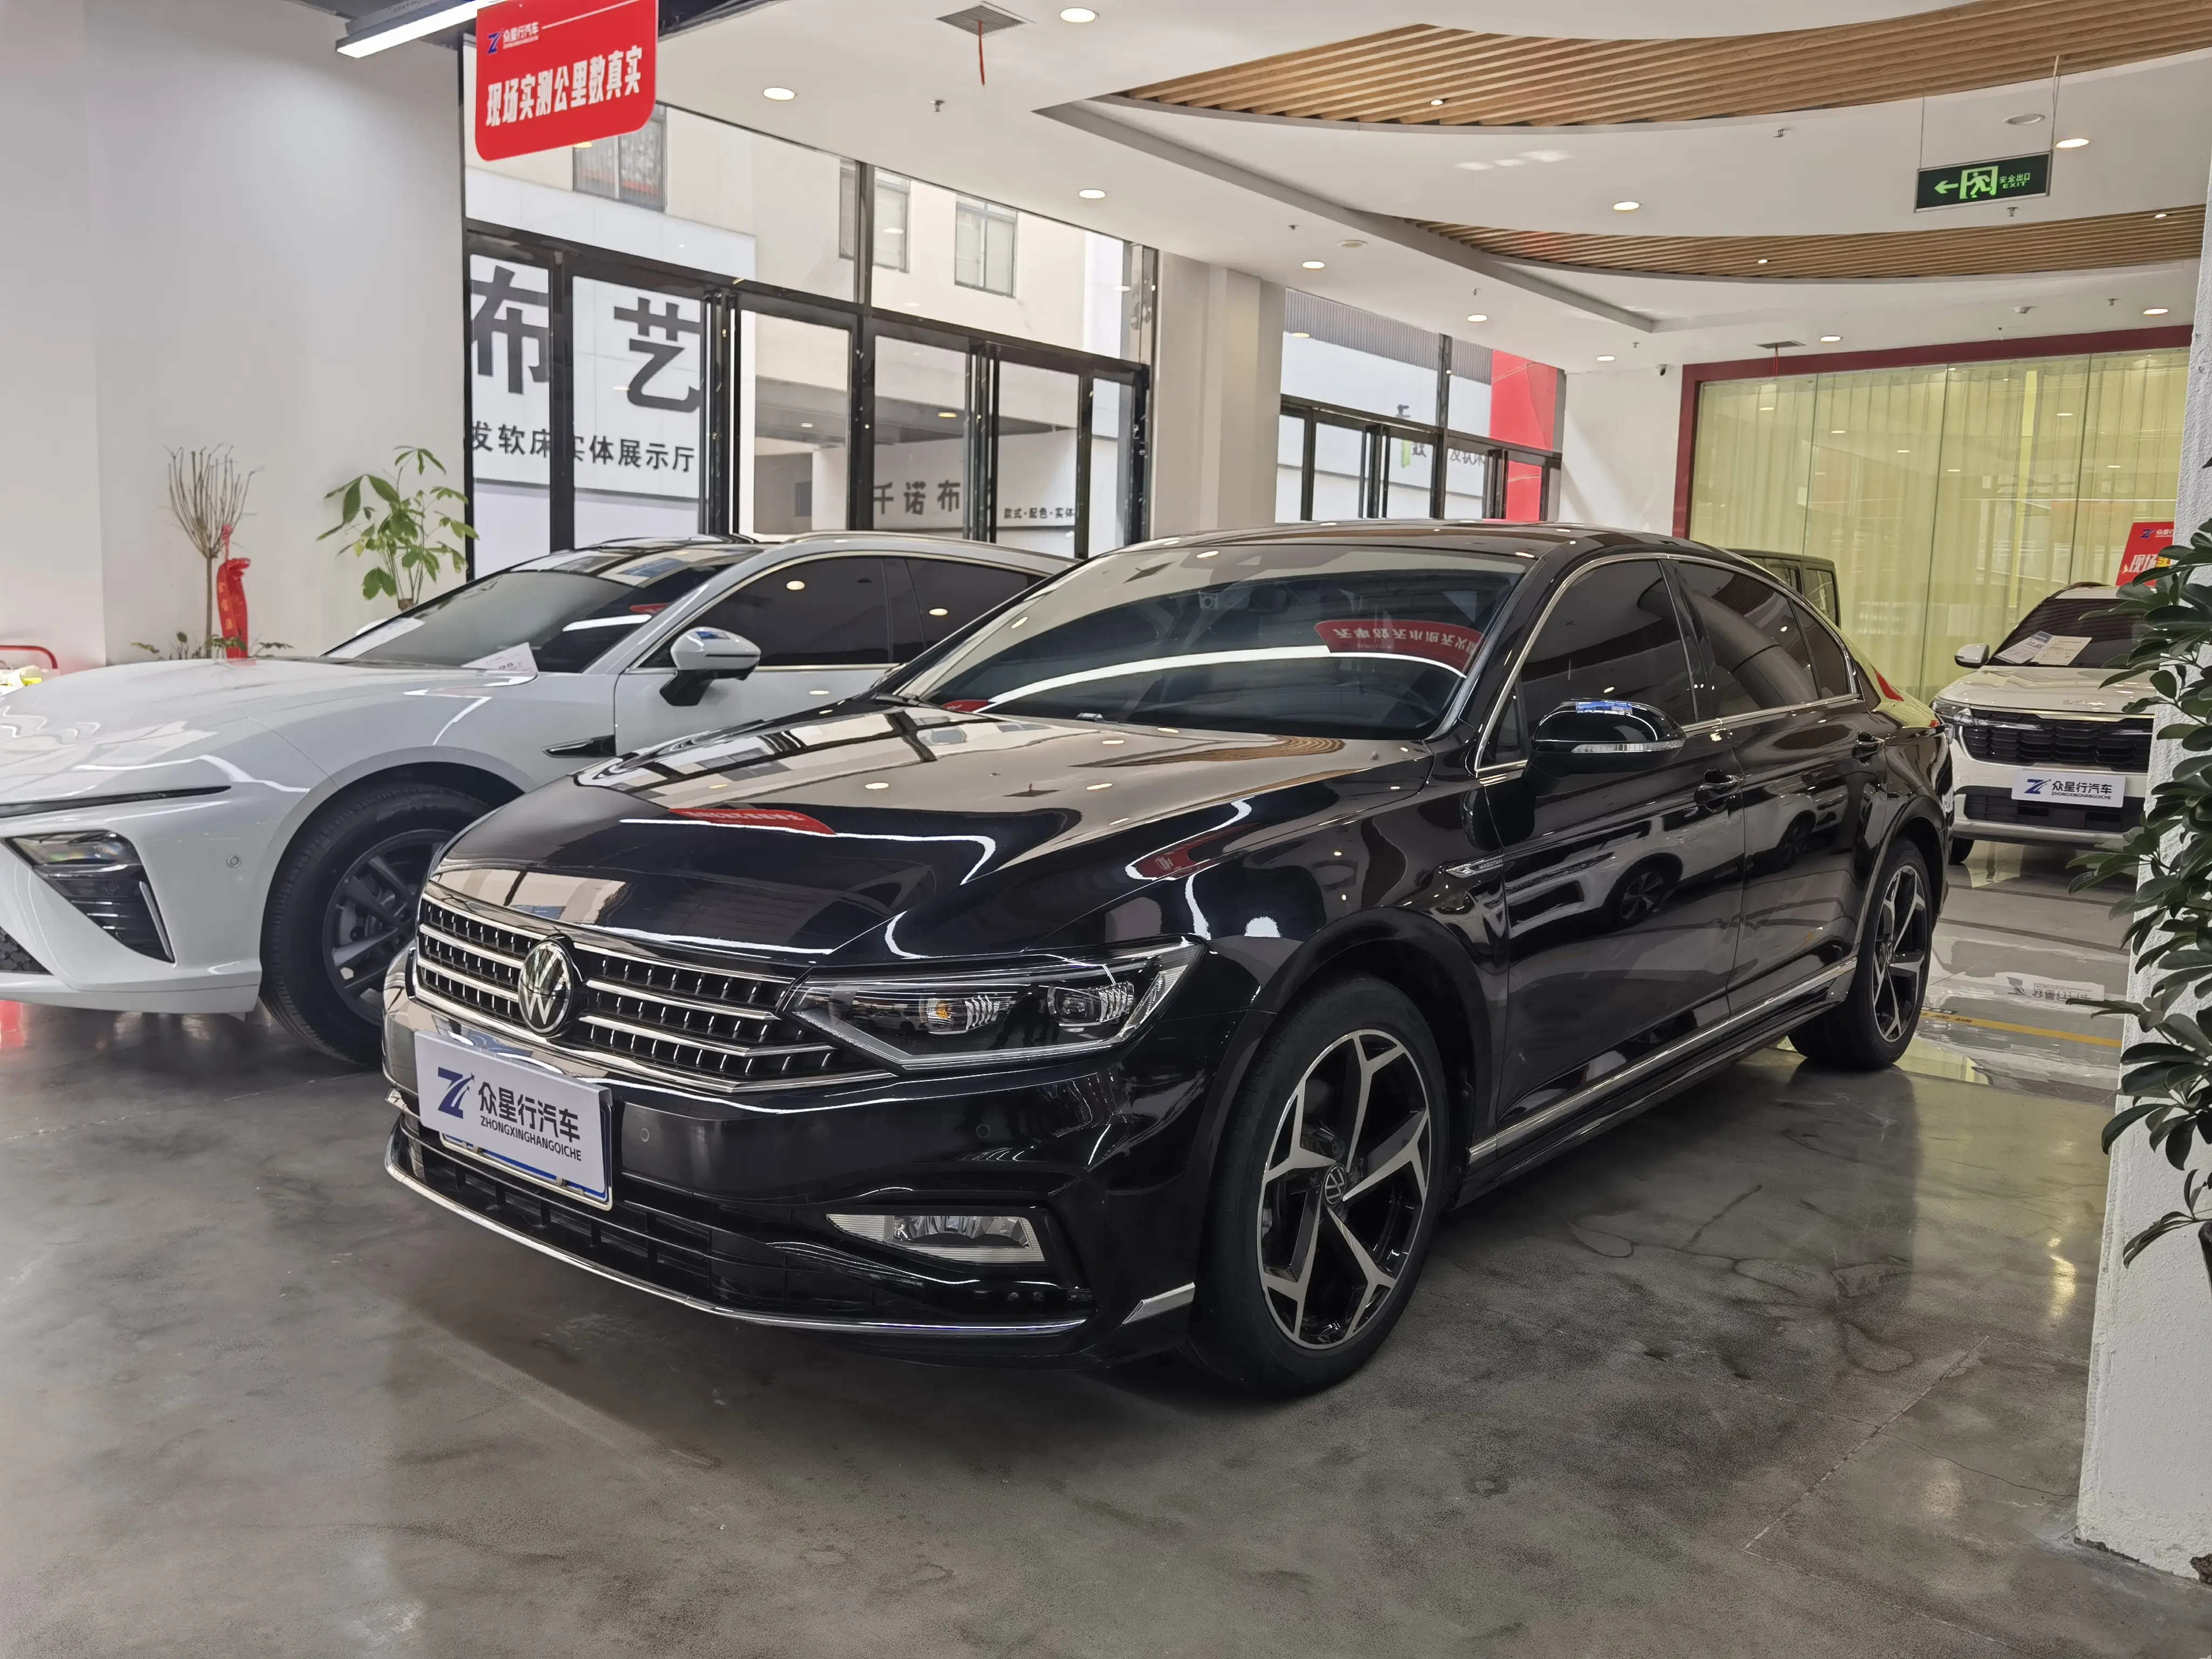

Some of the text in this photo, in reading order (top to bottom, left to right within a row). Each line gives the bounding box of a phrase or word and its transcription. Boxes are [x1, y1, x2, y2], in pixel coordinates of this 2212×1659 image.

[485, 45, 643, 127] 现场实测公里数真实
[1999, 172, 2031, 184] 安全出口
[2002, 181, 2027, 189] EXIT
[2052, 781, 2112, 794] 众星行汽车
[1479, 858, 1503, 869] MAGOTAN
[478, 1081, 581, 1143] 众星行汽车
[480, 1115, 582, 1162] ZHONGXINGHANGQICHE
